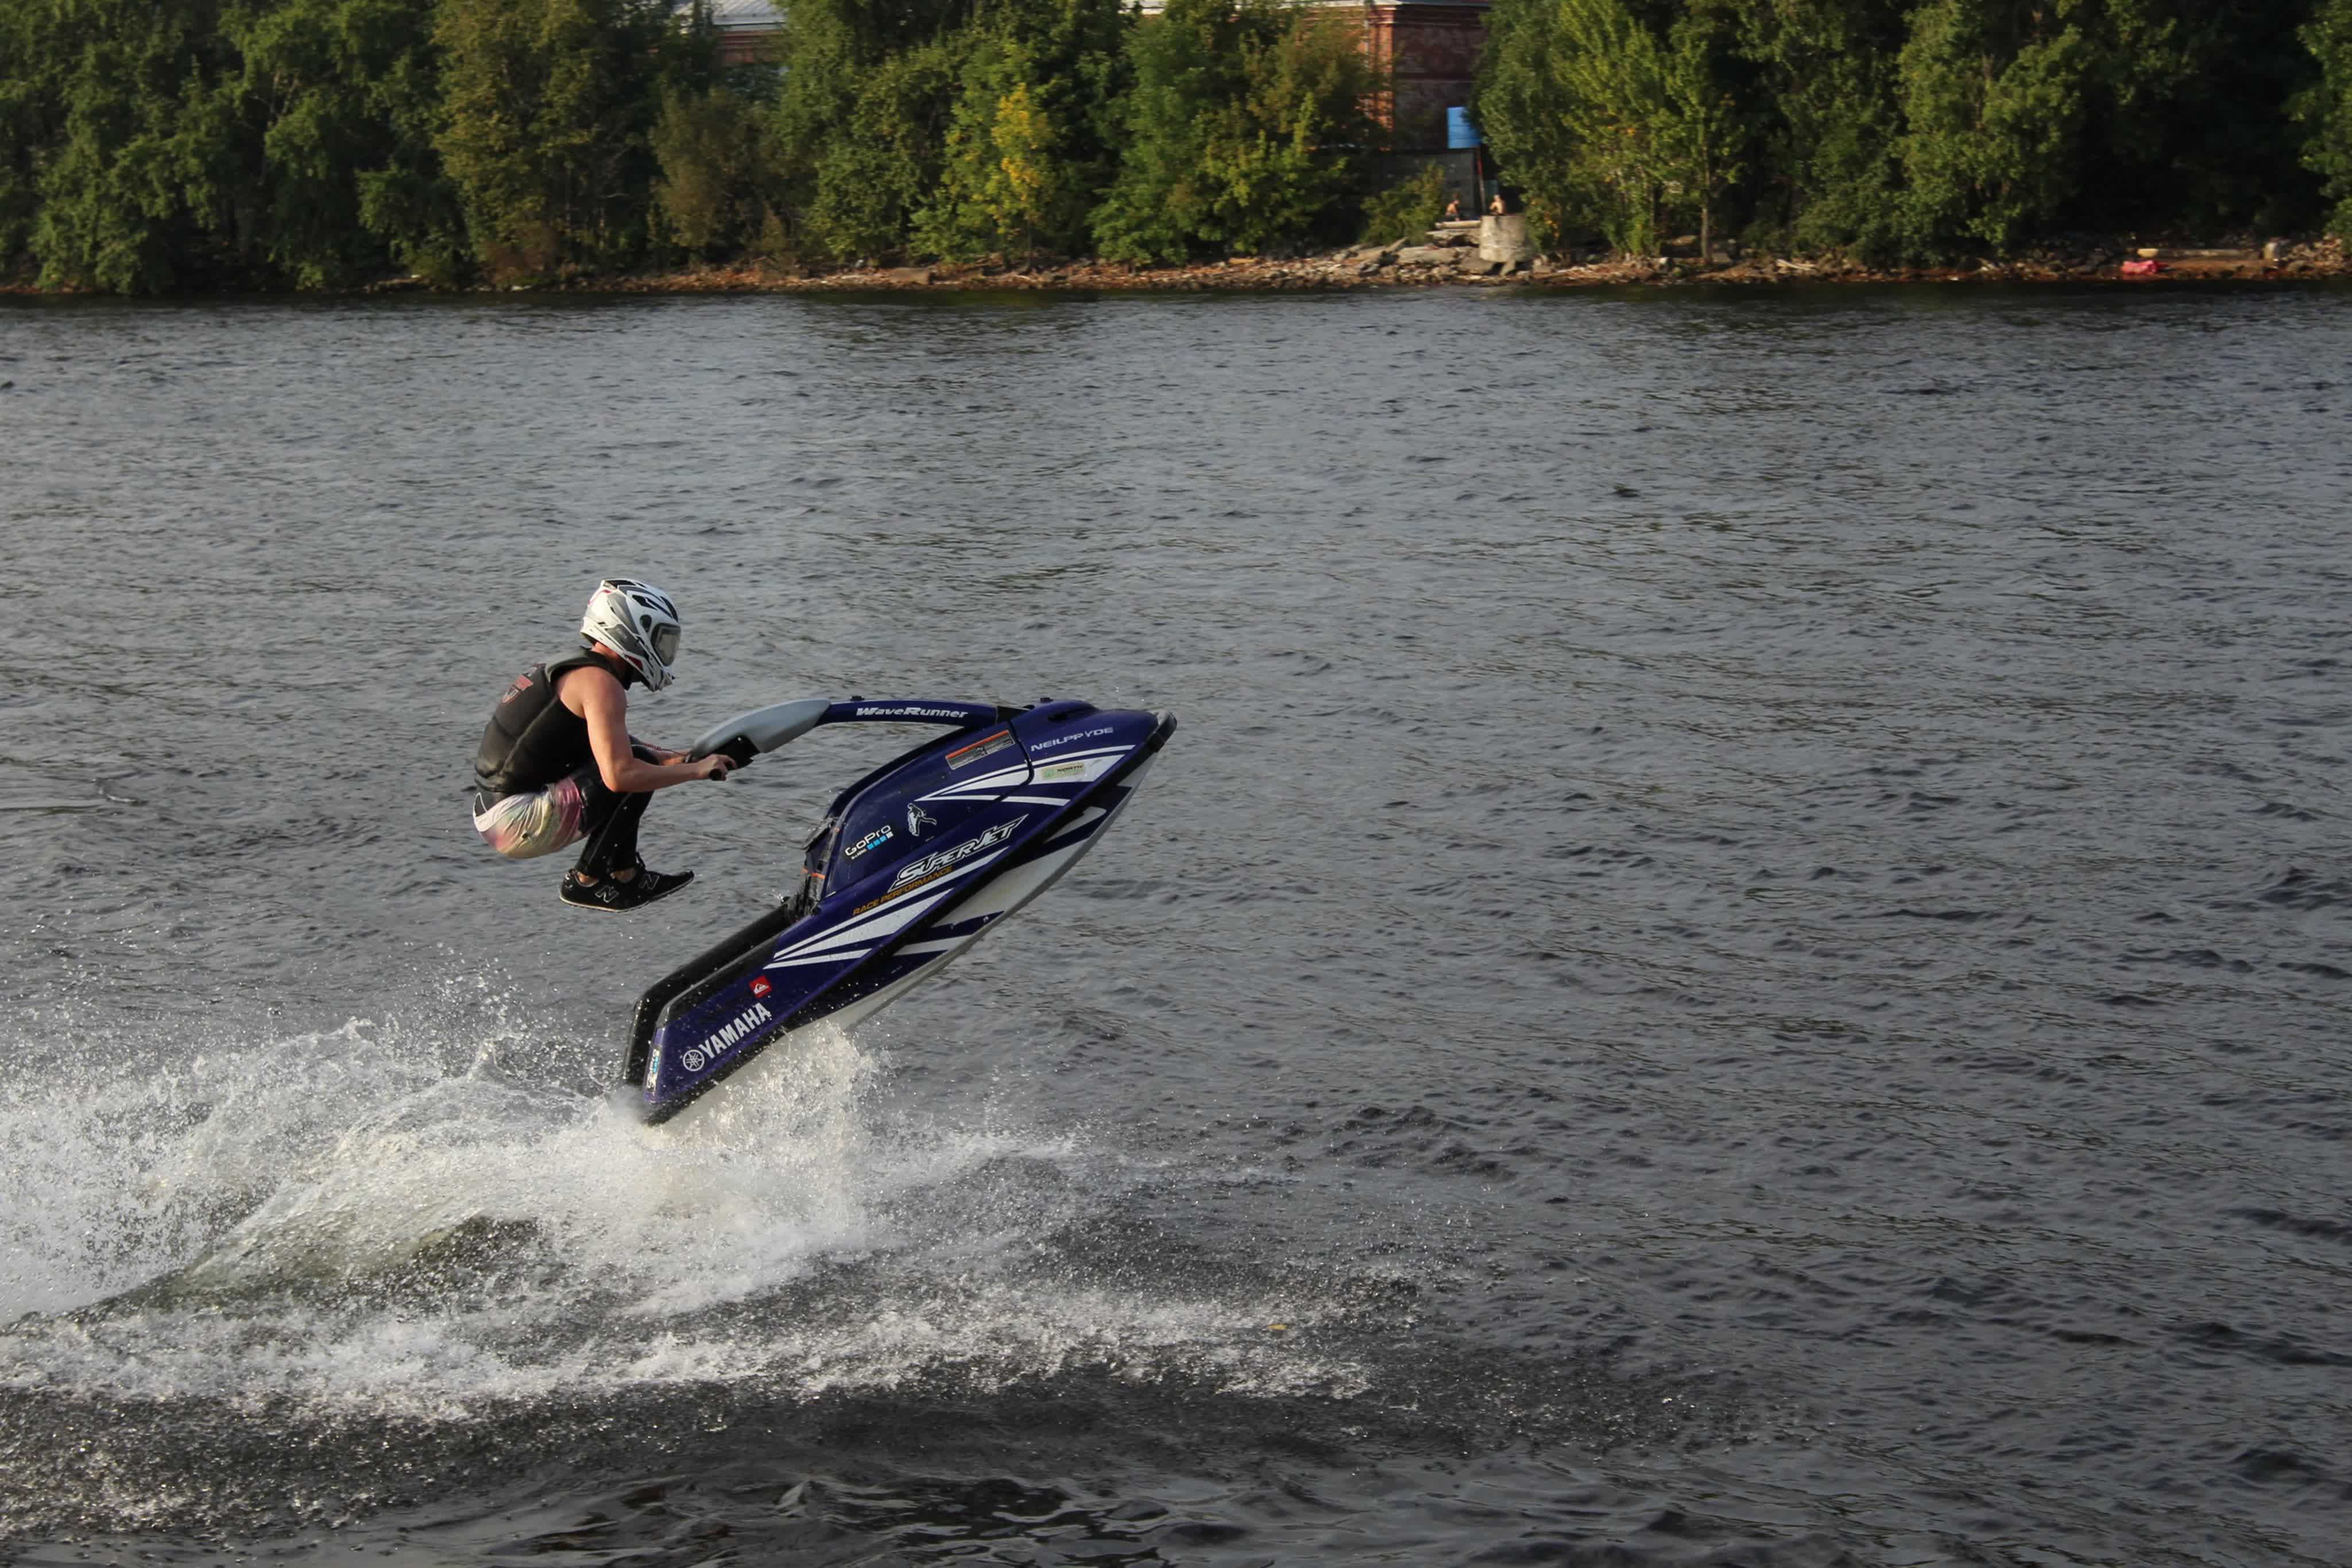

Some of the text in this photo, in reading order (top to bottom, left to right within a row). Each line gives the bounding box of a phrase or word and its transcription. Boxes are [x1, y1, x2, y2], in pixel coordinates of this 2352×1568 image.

[856, 707, 968, 718] WaveRunner
[845, 824, 891, 856] GoPro
[853, 865, 953, 916] RACE PERFORMANCE
[698, 1002, 772, 1059] YAMAHA
